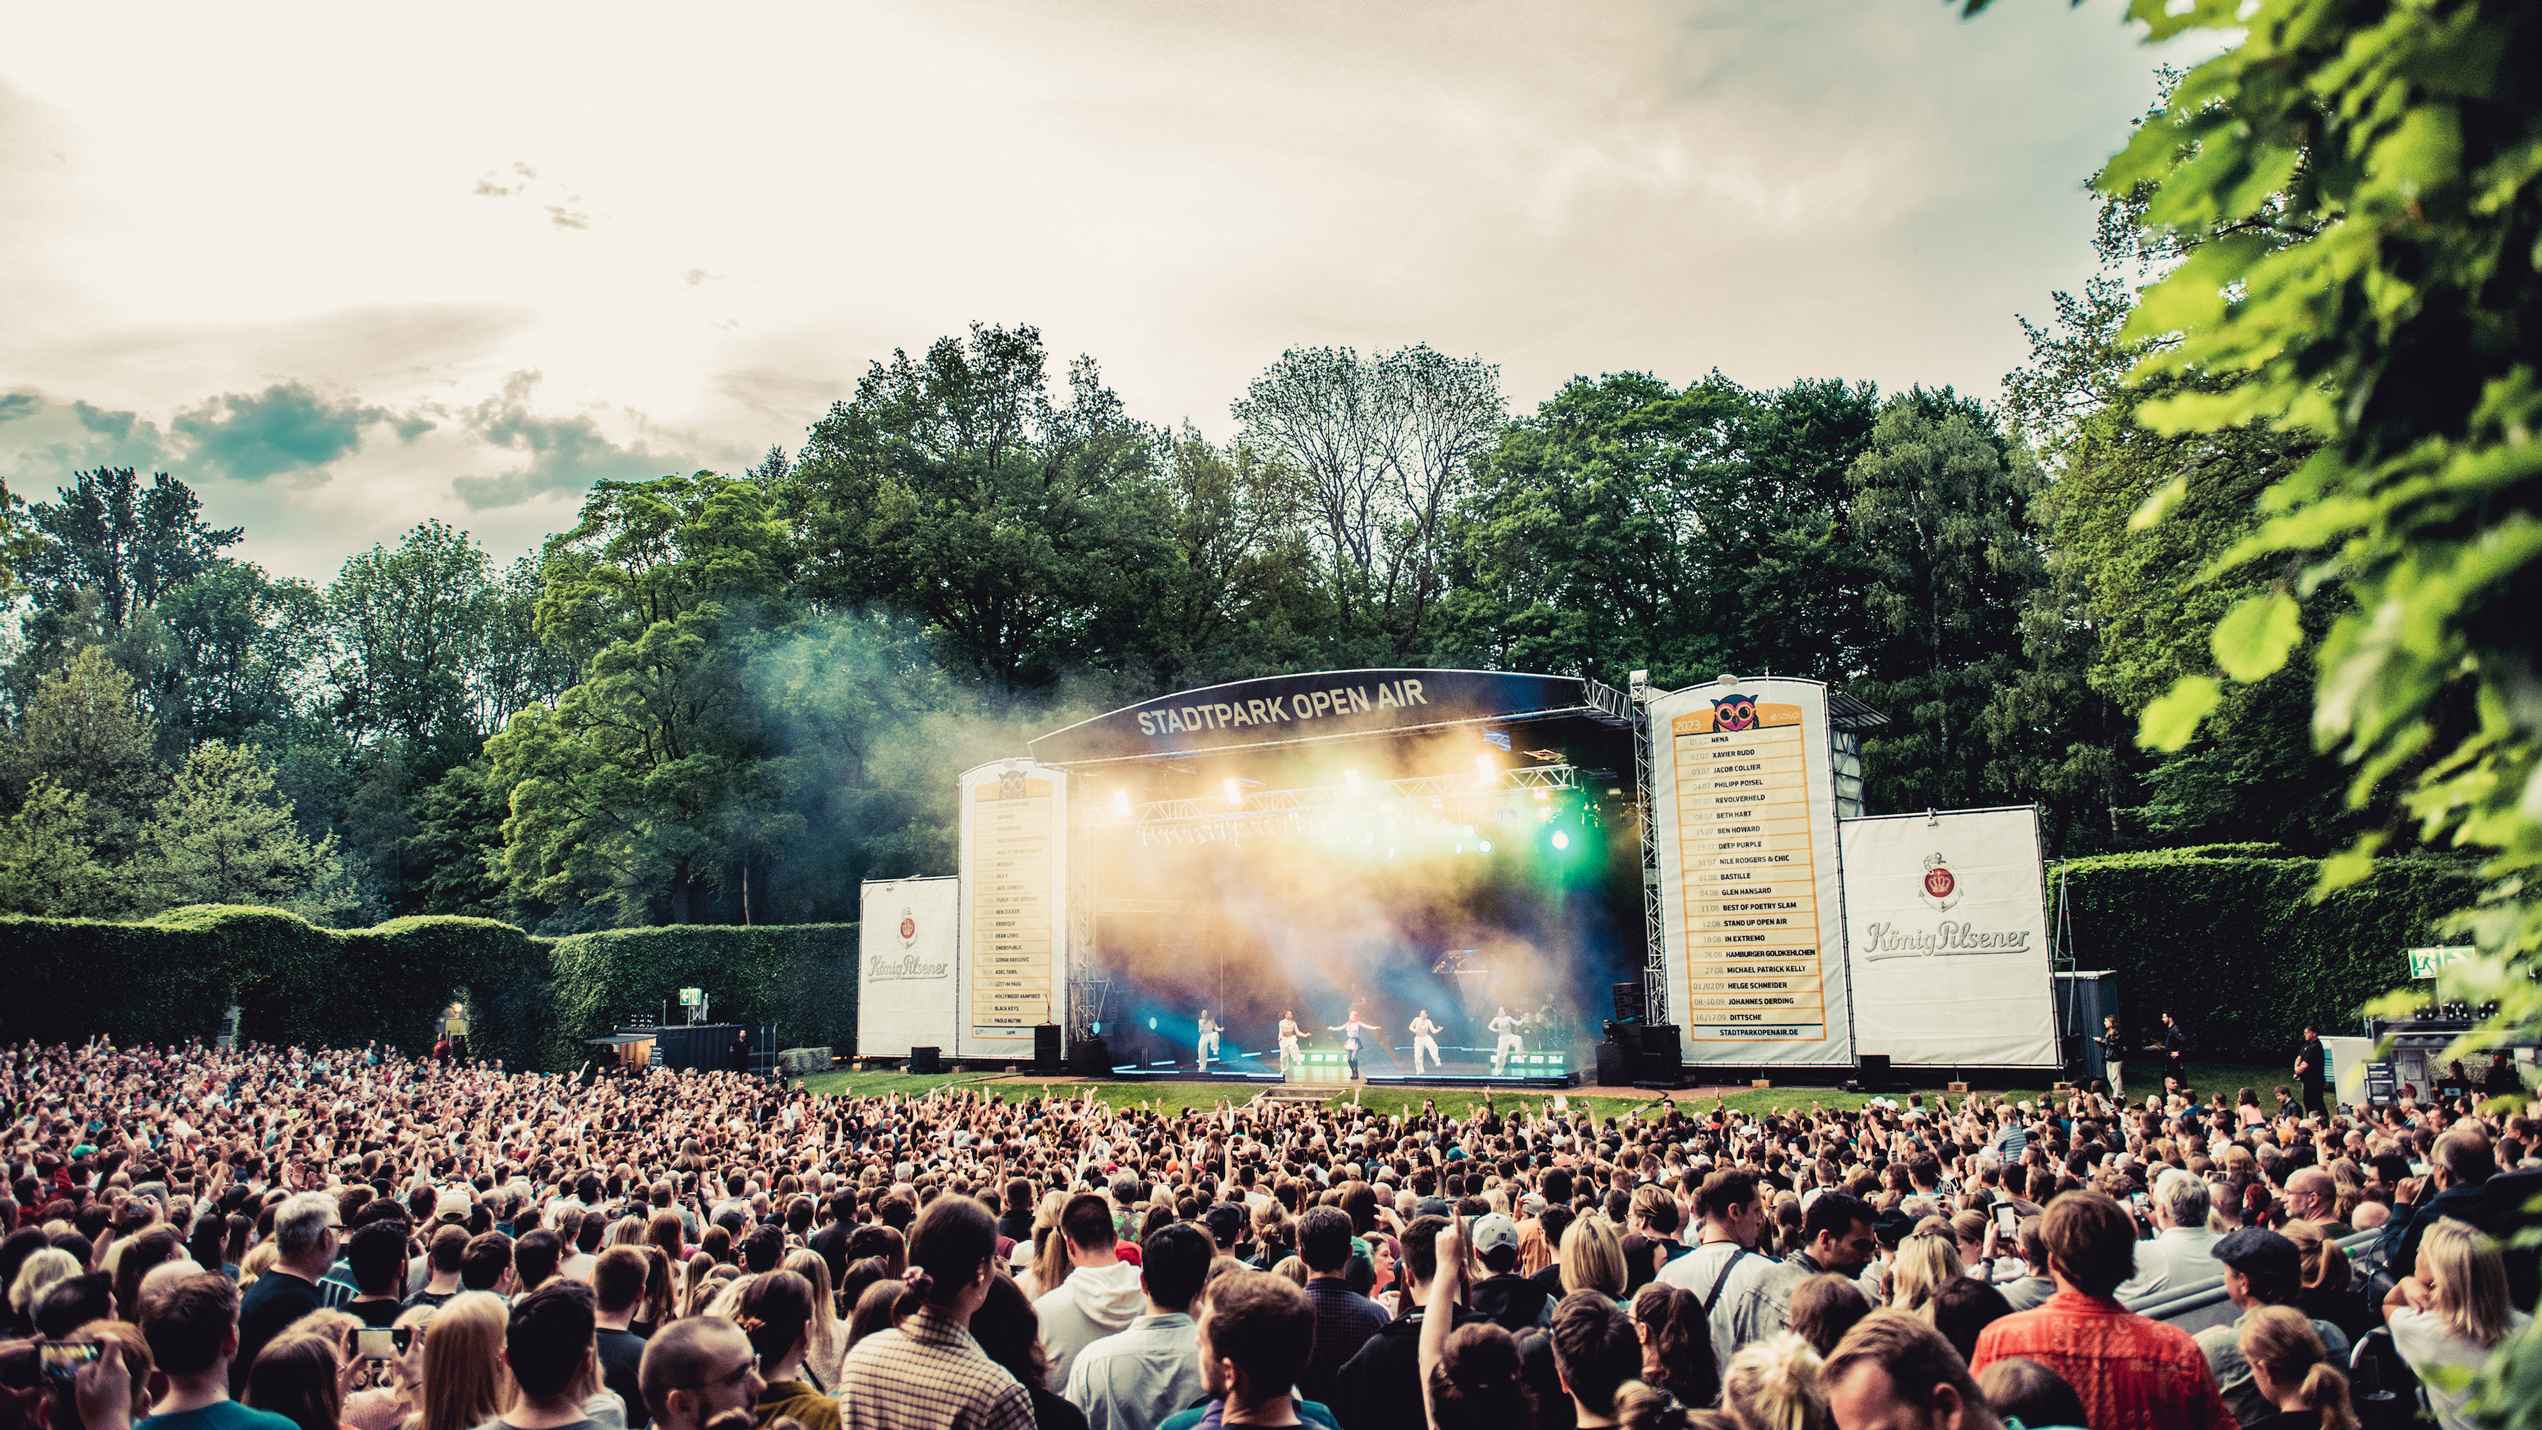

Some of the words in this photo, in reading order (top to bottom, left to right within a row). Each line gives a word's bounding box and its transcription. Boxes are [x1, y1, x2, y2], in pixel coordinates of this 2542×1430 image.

[1137, 696, 1291, 737] STADTPARK
[1292, 686, 1371, 720] OPEN
[1377, 679, 1428, 710] AIR
[1711, 736, 1729, 744] NENA
[1712, 750, 1736, 759] XAVIER
[1736, 749, 1755, 757] RUDD
[1713, 766, 1733, 774] JACOB
[1734, 764, 1761, 773] COLLIER
[1714, 781, 1739, 789] PHILIPP
[1740, 779, 1763, 787] POISEL
[1715, 794, 1766, 804] REVOLVERHELD
[1716, 811, 1733, 819] BETH
[1734, 810, 1752, 818] HART
[1717, 827, 1731, 835] BEN
[1731, 826, 1760, 834] HOWARD
[1718, 842, 1736, 850] DEEP
[1737, 841, 1762, 849] PURPLE
[1720, 872, 1751, 880] BASTILLE
[1740, 887, 1772, 895] HANSARD
[1750, 902, 1776, 910] POETRY
[1777, 901, 1797, 909] SLAM
[1723, 919, 1745, 927] STAND
[1756, 918, 1775, 926] OPEN
[1724, 935, 1732, 943] IN
[1733, 934, 1765, 942] EXTREMO
[1863, 921, 1936, 957] König
[1937, 920, 2030, 950] Pilsener
[1726, 950, 1765, 958] HAMBURGER
[1765, 949, 1816, 957] GOLDKEHLCHEN
[868, 954, 903, 978] König
[902, 954, 948, 976] Pilsener
[1756, 965, 1784, 973] PATRICK
[1750, 981, 1788, 989] SCHNEIDER
[1764, 997, 1794, 1005] OERDING
[1719, 1028, 1799, 1036] STADTPARKOPENAIR.DE
